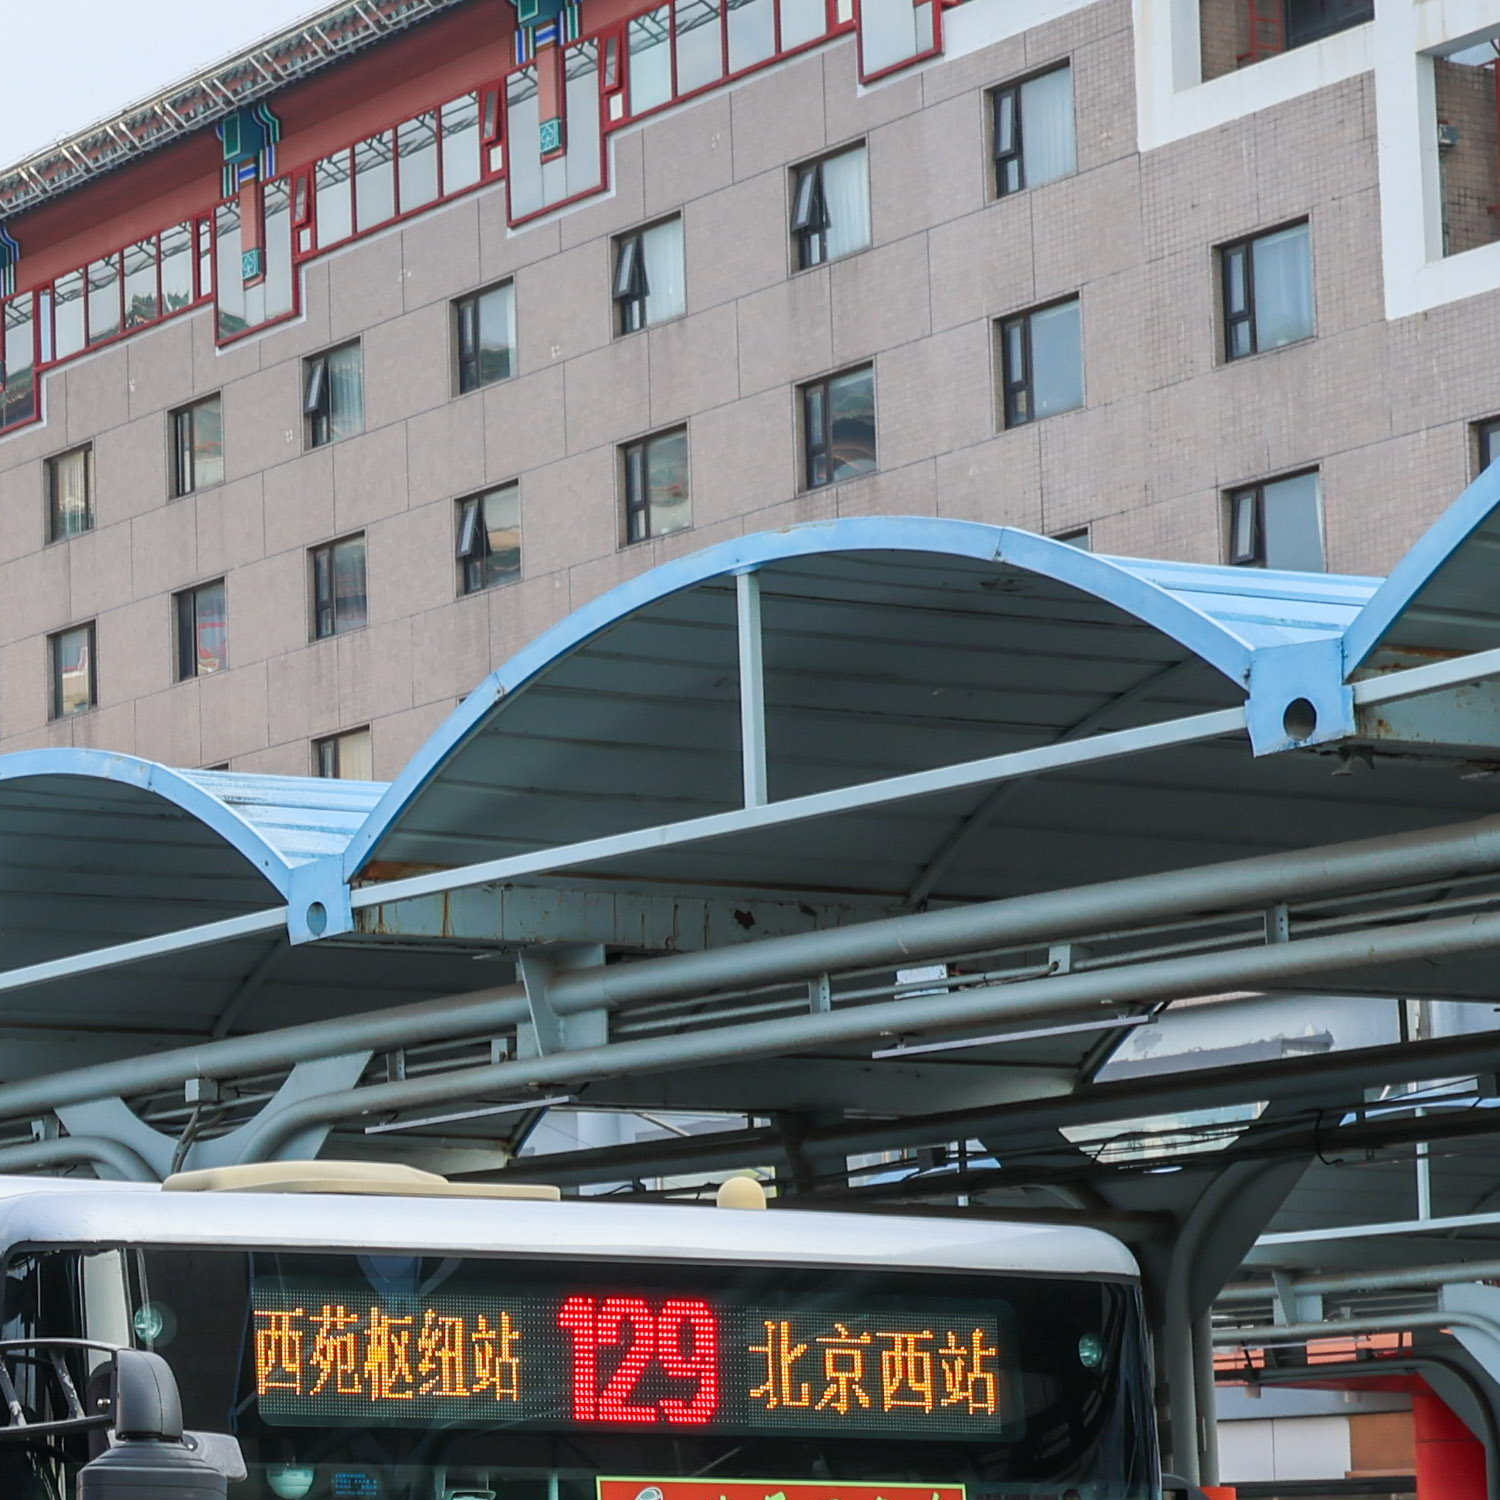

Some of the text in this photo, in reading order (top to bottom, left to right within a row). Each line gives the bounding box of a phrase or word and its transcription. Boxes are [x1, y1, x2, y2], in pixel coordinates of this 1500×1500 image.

[254, 1296, 997, 1424] 西苑枢纽站 129 北京西站
